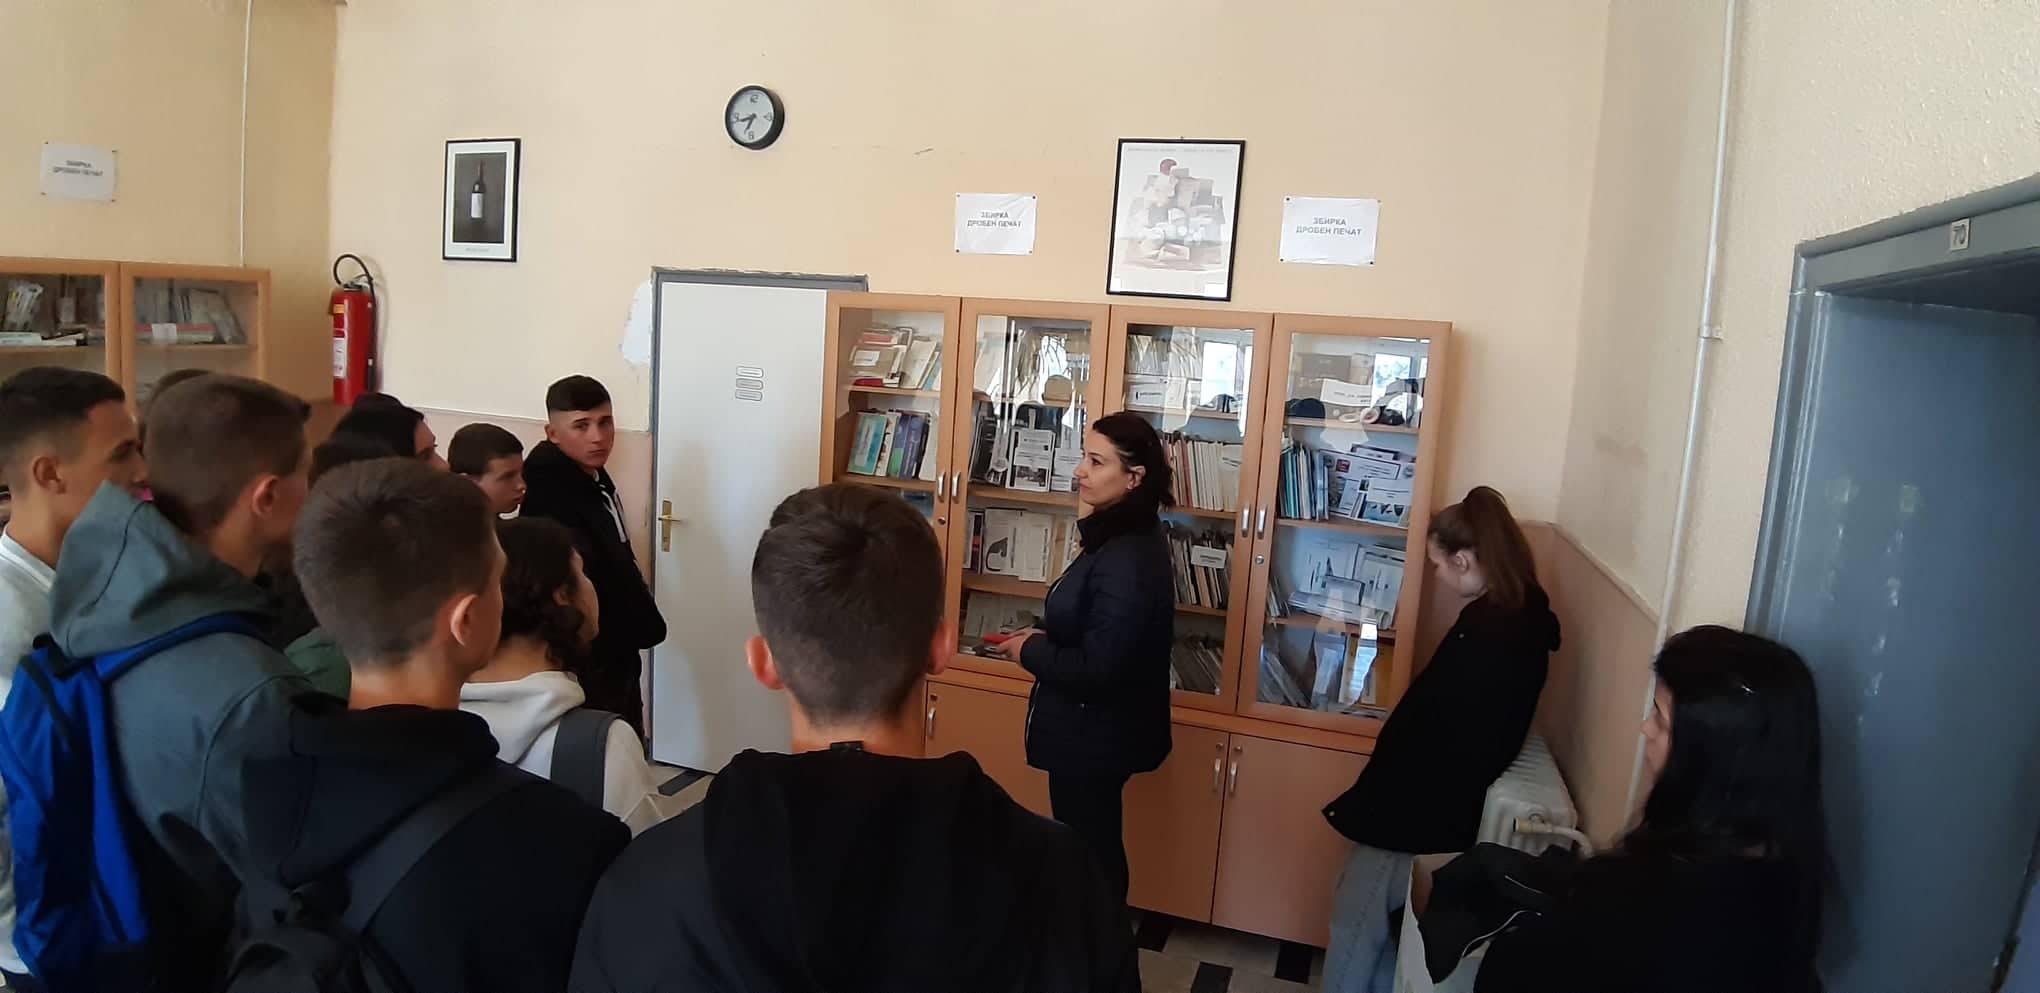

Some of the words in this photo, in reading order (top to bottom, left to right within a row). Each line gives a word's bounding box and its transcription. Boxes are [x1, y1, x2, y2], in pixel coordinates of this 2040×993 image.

[981, 211, 1009, 219] ЗБИРКА
[1313, 217, 1346, 226] ЗБИРКА
[1296, 226, 1331, 235] ДРОБЕН
[1333, 227, 1362, 236] ПЕЧАТ
[1953, 223, 1967, 246] 70
